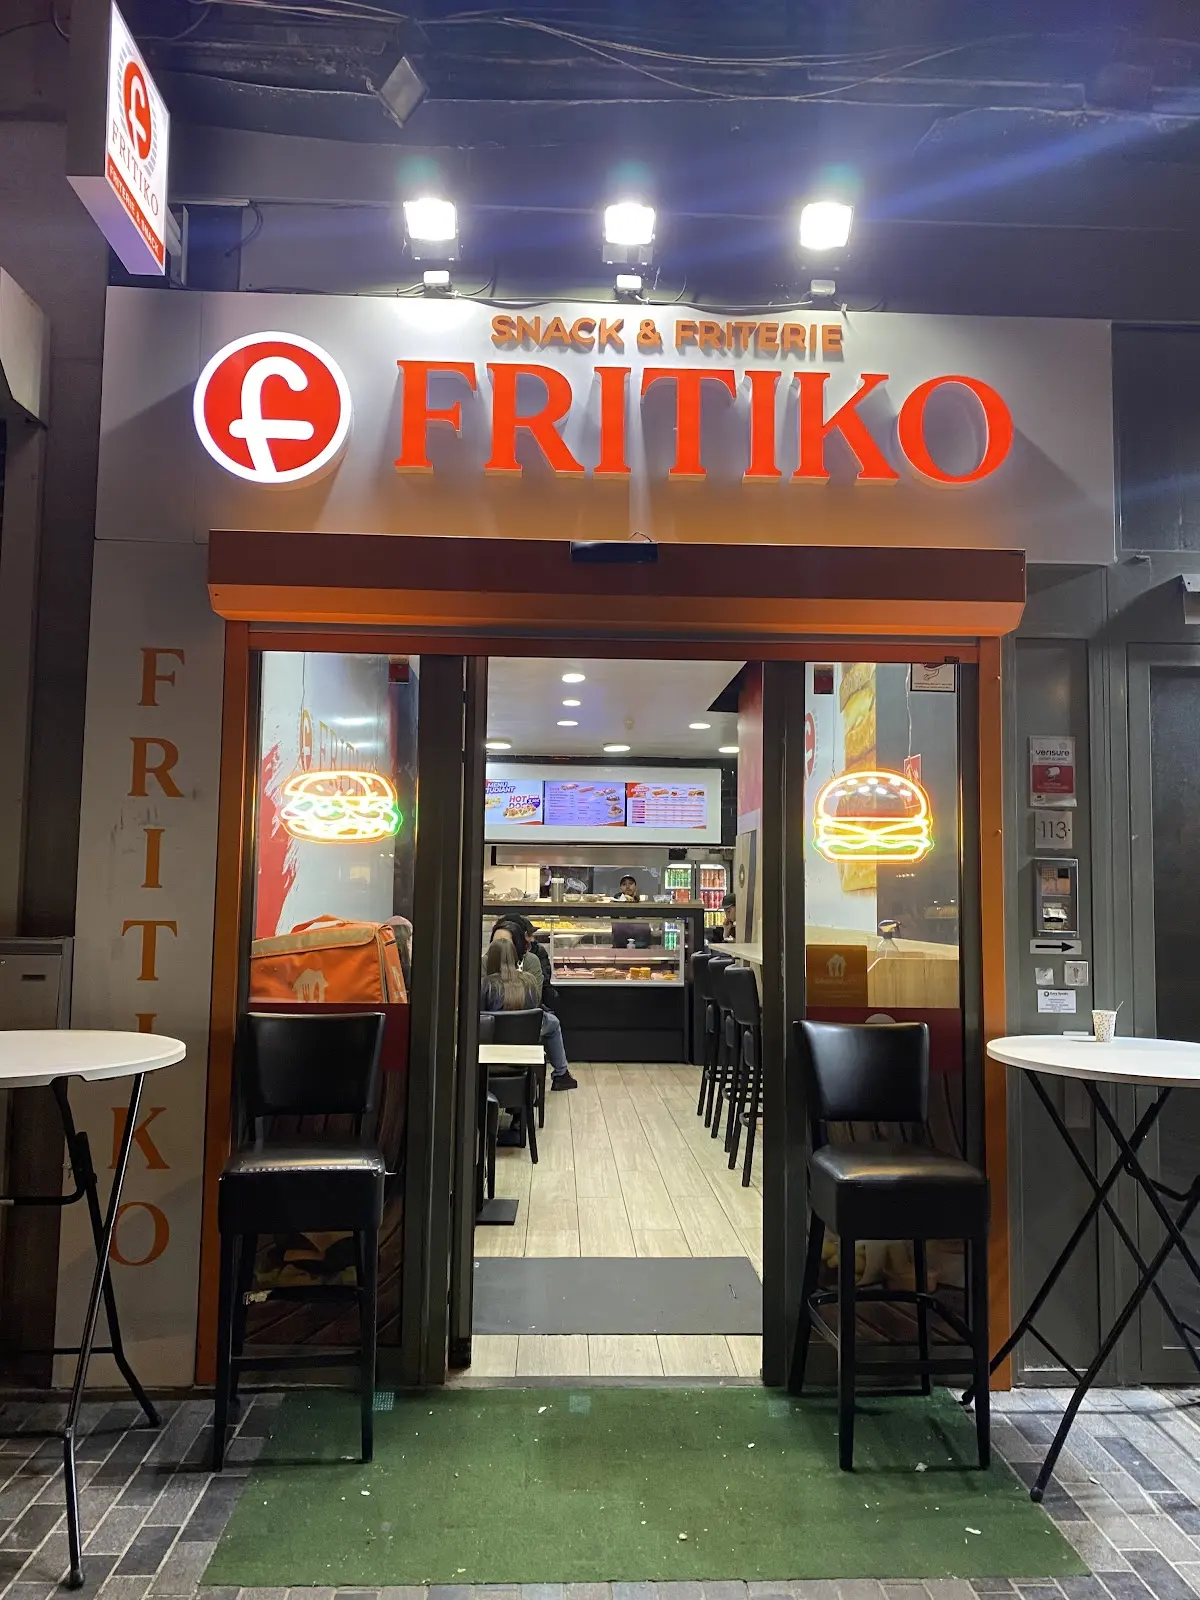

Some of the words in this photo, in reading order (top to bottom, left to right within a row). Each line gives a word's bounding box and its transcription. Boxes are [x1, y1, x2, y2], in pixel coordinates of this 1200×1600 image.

[112, 119, 159, 216] FRITIKO
[109, 164, 136, 216] FRITERIE
[140, 218, 161, 257] SNACK
[490, 314, 625, 347] SNACK
[636, 318, 662, 347] &
[674, 319, 843, 353] FRITERIE
[393, 359, 1014, 486] FRITIKO
[1035, 749, 1070, 757] verisure
[509, 795, 528, 803] HOT
[1040, 820, 1067, 839] 113
